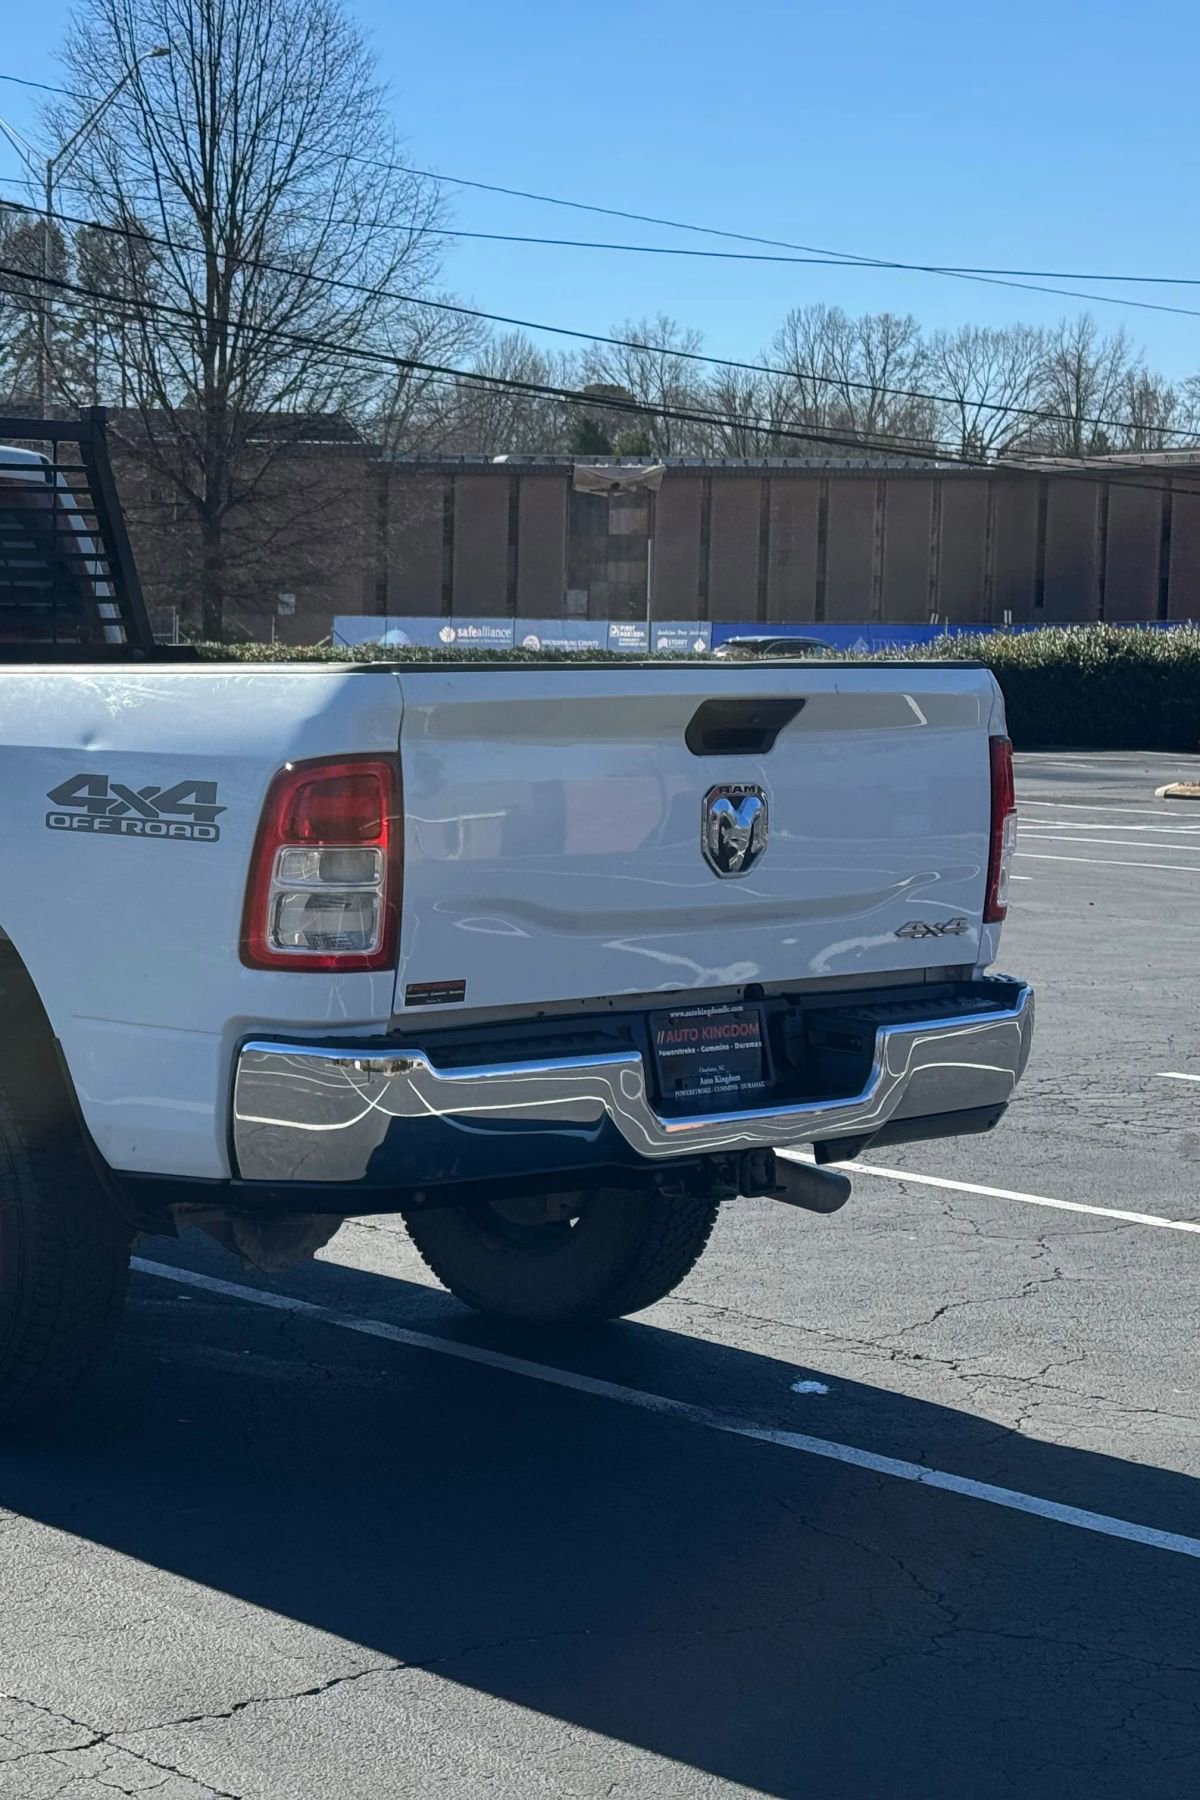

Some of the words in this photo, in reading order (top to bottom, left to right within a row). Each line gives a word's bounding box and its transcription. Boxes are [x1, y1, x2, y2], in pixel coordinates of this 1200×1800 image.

[457, 625, 512, 638] safealliance
[720, 785, 756, 794] RAM
[49, 814, 113, 830] OFF
[120, 820, 217, 840] ROAD
[701, 1022, 760, 1041] KINGDOM
[700, 1043, 730, 1053] Cummins
[734, 1040, 763, 1050] Duramax
[700, 1077, 714, 1086] Auto
[714, 1073, 741, 1084] Kingdom
